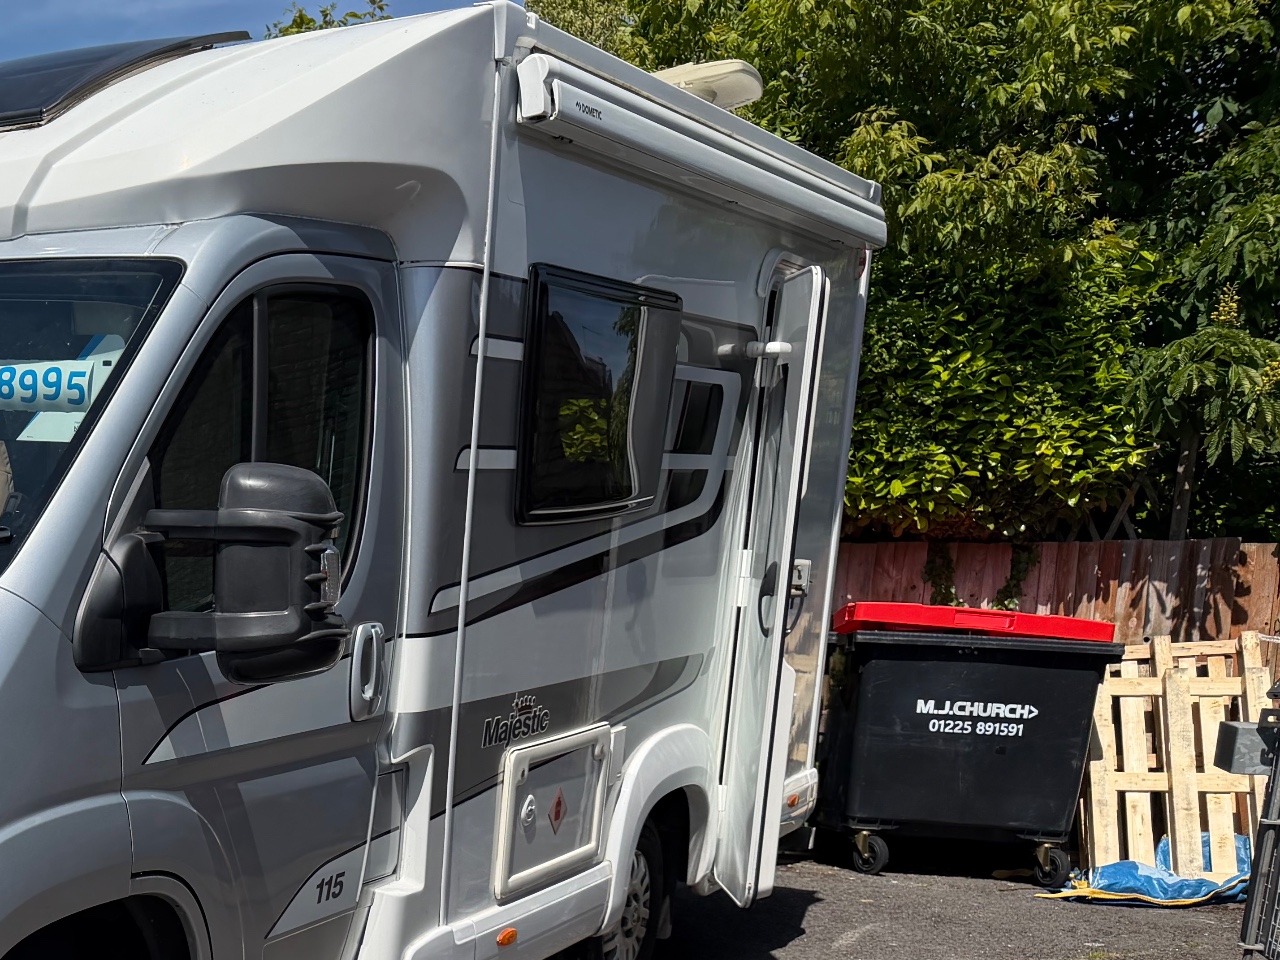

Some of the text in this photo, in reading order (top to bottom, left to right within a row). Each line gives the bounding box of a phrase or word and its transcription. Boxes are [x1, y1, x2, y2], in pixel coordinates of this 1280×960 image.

[582, 103, 602, 120] DOMETIC
[481, 705, 550, 749] Majestic
[928, 719, 1024, 737] 01225 891591
[316, 871, 346, 905] 115
